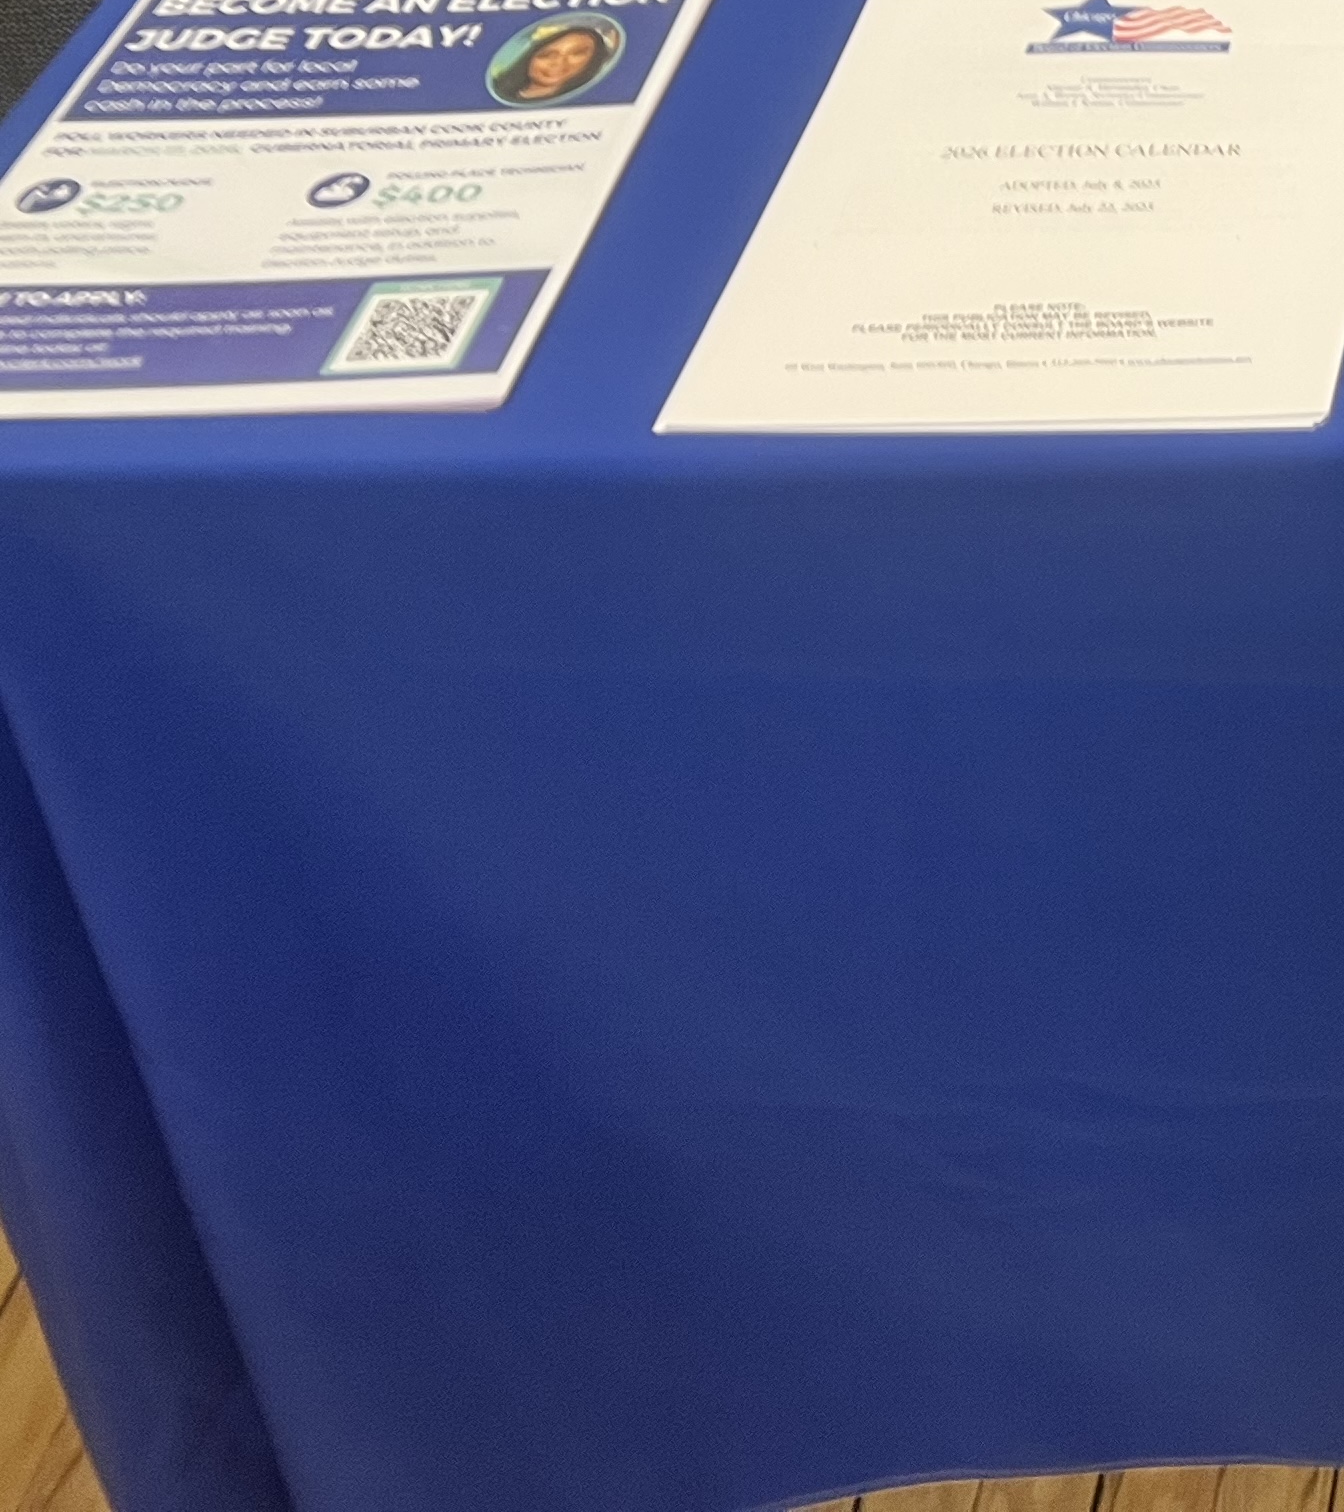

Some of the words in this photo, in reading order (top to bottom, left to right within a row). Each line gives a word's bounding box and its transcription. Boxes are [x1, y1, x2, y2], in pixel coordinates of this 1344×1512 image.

[122, 27, 296, 53] JUDGE
[302, 21, 484, 51] TODAY!
[994, 142, 1109, 159] ELECTION
[1114, 141, 1242, 159] CALENDAR
